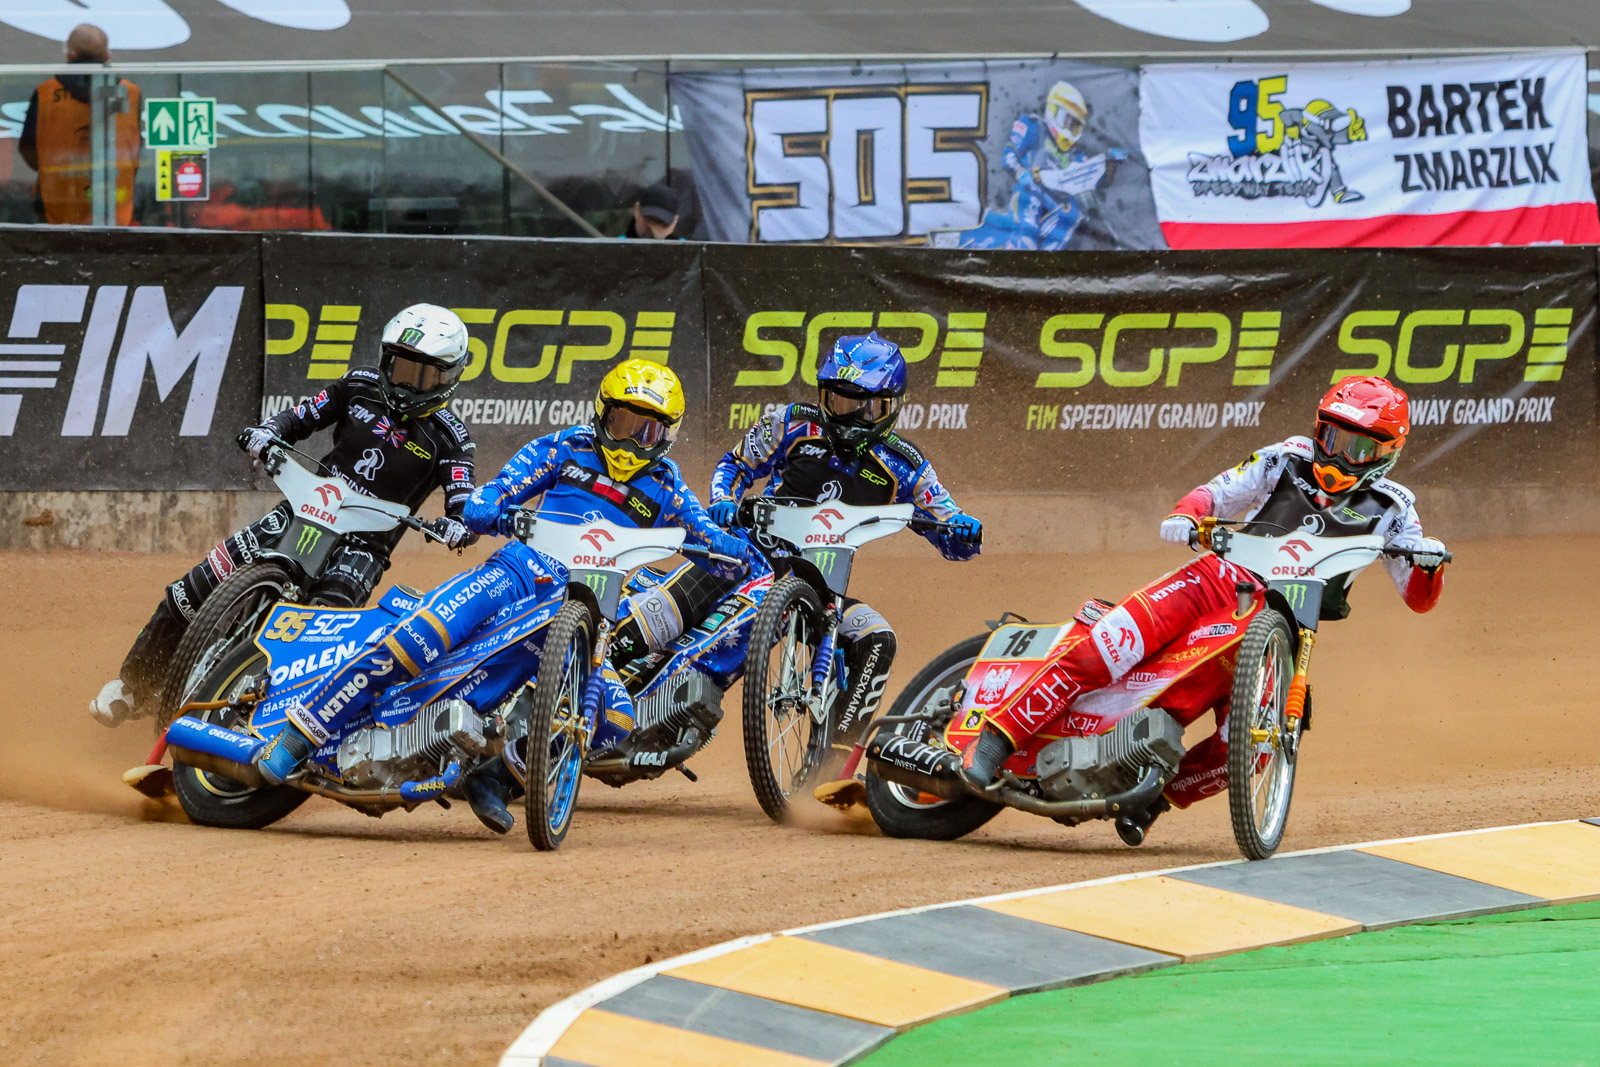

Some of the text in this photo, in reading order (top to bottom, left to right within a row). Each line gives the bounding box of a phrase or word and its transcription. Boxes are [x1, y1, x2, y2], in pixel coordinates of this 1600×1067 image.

[1228, 75, 1288, 158] 95
[1386, 77, 1553, 139] BARTEK
[451, 398, 598, 425] SPEEDWAY GRAN
[728, 403, 762, 430] FIM
[926, 403, 970, 430] PRIX
[1026, 401, 1265, 430] FIM SPEEDWAY GRAND PRIX
[1452, 398, 1515, 425] GRAND
[1514, 396, 1556, 424] PRIX
[403, 440, 432, 460] SGP
[800, 444, 828, 459] FIM
[1296, 442, 1313, 453] ORL
[561, 465, 592, 482] FIM
[859, 468, 889, 486] SGP
[300, 503, 337, 524] ORLEN
[628, 496, 652, 519] SGP
[1341, 506, 1368, 522] SGP
[804, 533, 847, 545] ORLEN
[573, 555, 617, 567] ORLEN
[1271, 566, 1316, 577] ORLEN
[172, 580, 199, 619] GARCAR
[434, 567, 506, 623] MASZOŃSKI
[486, 577, 513, 600] logistic
[1149, 579, 1187, 603] ORLEN
[264, 610, 316, 643] 95
[304, 613, 362, 636] SGP
[1001, 629, 1038, 658] 16
[1100, 631, 1122, 664] ORLEN
[270, 640, 357, 687] ORLEN
[837, 642, 884, 733] WESSEXMARINE
[1127, 671, 1158, 682] AUTO
[317, 672, 369, 724] ORLEN
[1017, 672, 1070, 726] KJH
[1044, 698, 1067, 723] INVEST
[208, 727, 239, 743] ORLEN
[315, 745, 342, 759] ANLA
[890, 737, 944, 765] KJH
[894, 758, 917, 772] INVEST
[1171, 764, 1229, 792] astermedia
